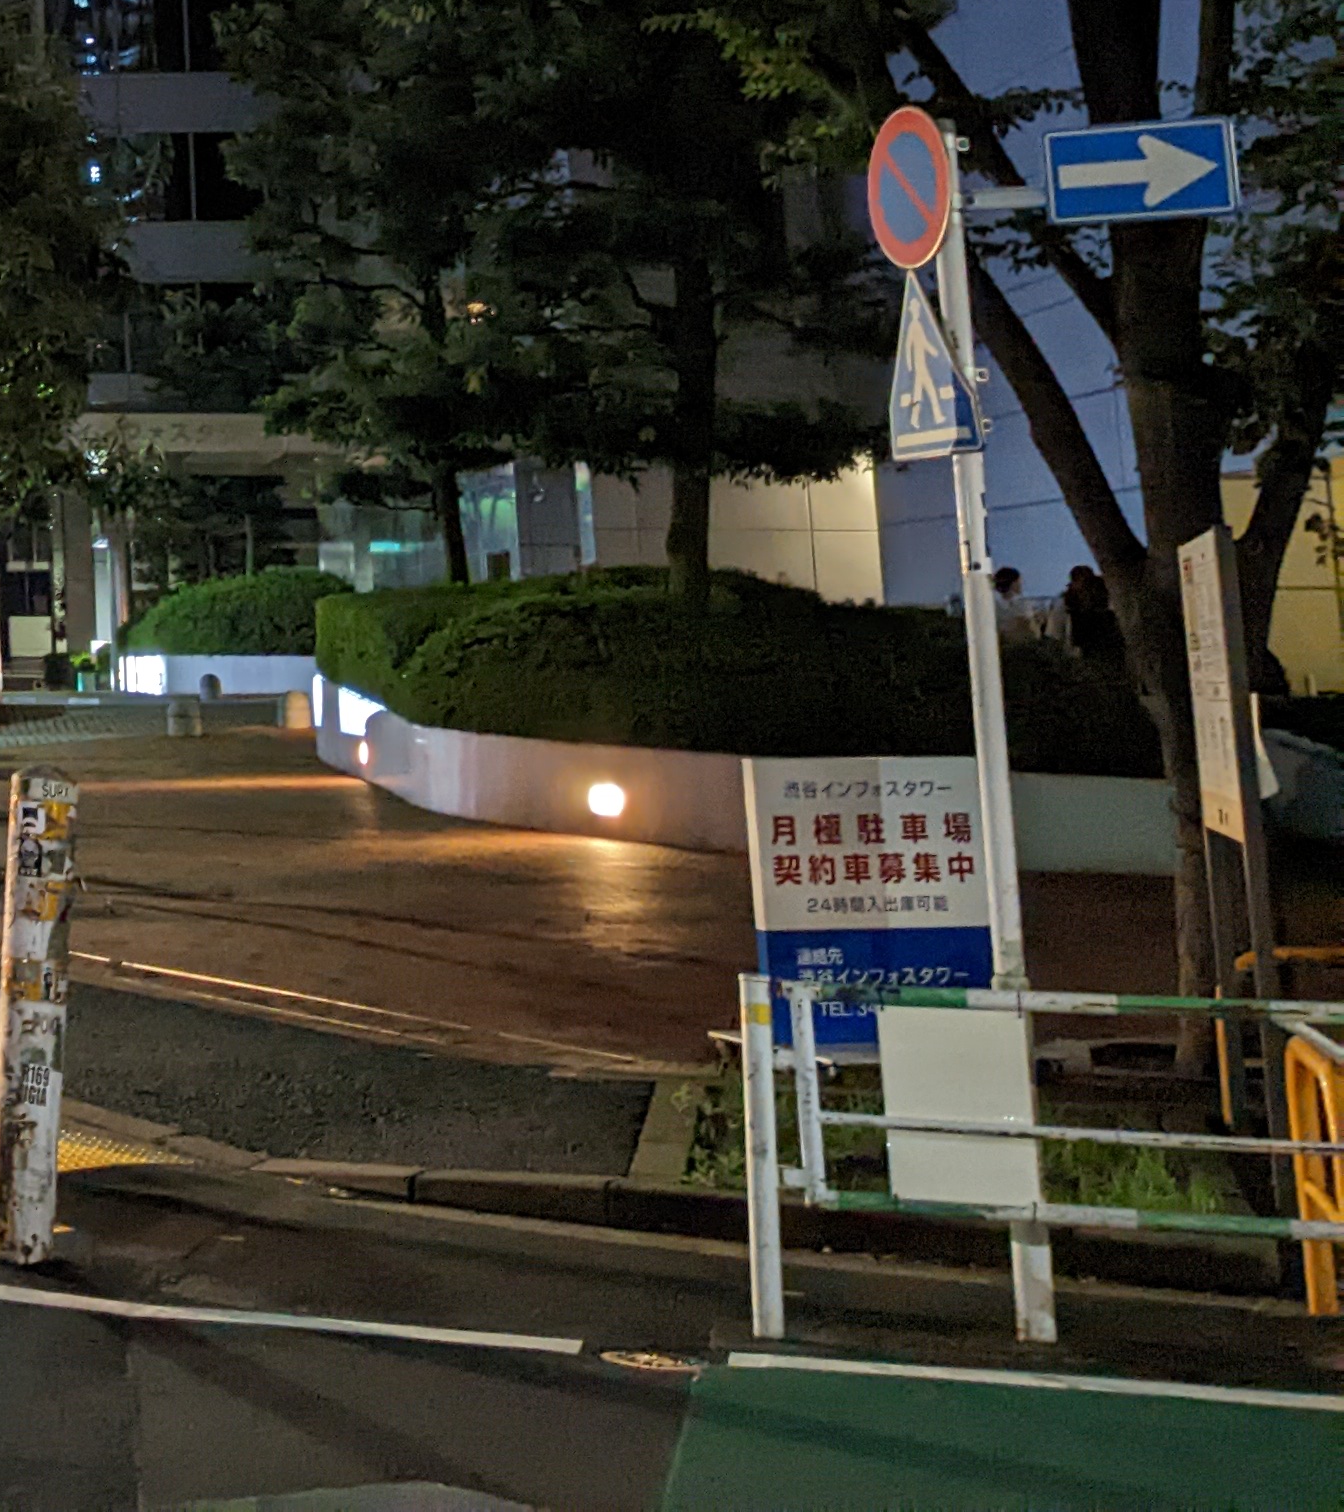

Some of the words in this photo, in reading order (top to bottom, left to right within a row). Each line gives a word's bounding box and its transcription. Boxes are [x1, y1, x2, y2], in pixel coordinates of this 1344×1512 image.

[783, 780, 952, 800] 渋谷インフォスタワー
[771, 812, 972, 846] 月極駐車場
[772, 851, 976, 886] 契約車募集中
[806, 894, 950, 914] 24時間入出庫可能
